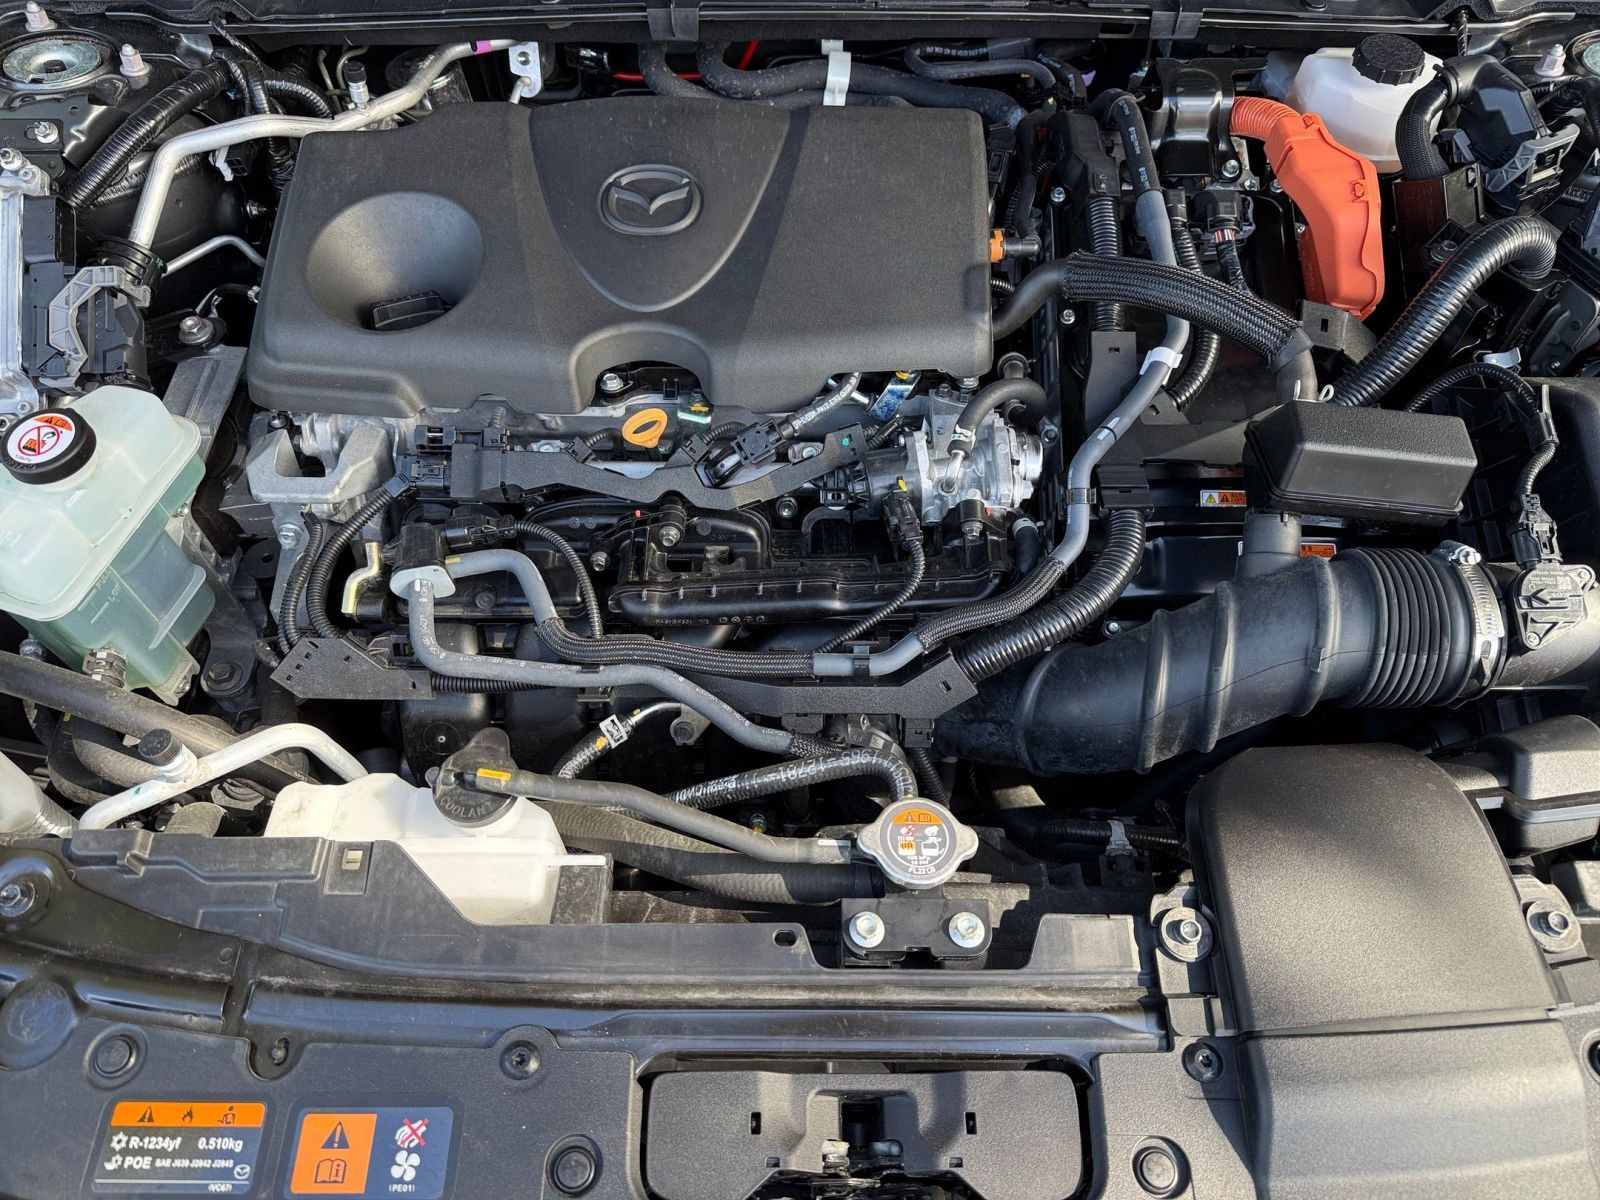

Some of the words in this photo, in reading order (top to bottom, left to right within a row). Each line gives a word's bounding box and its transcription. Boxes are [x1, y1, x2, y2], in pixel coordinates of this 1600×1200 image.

[441, 796, 493, 818] COOLANT
[129, 1136, 182, 1152] R-1234yf
[197, 1137, 243, 1153] 0.510kg
[124, 1156, 152, 1169] POE
[388, 1183, 416, 1193] (PE01)
